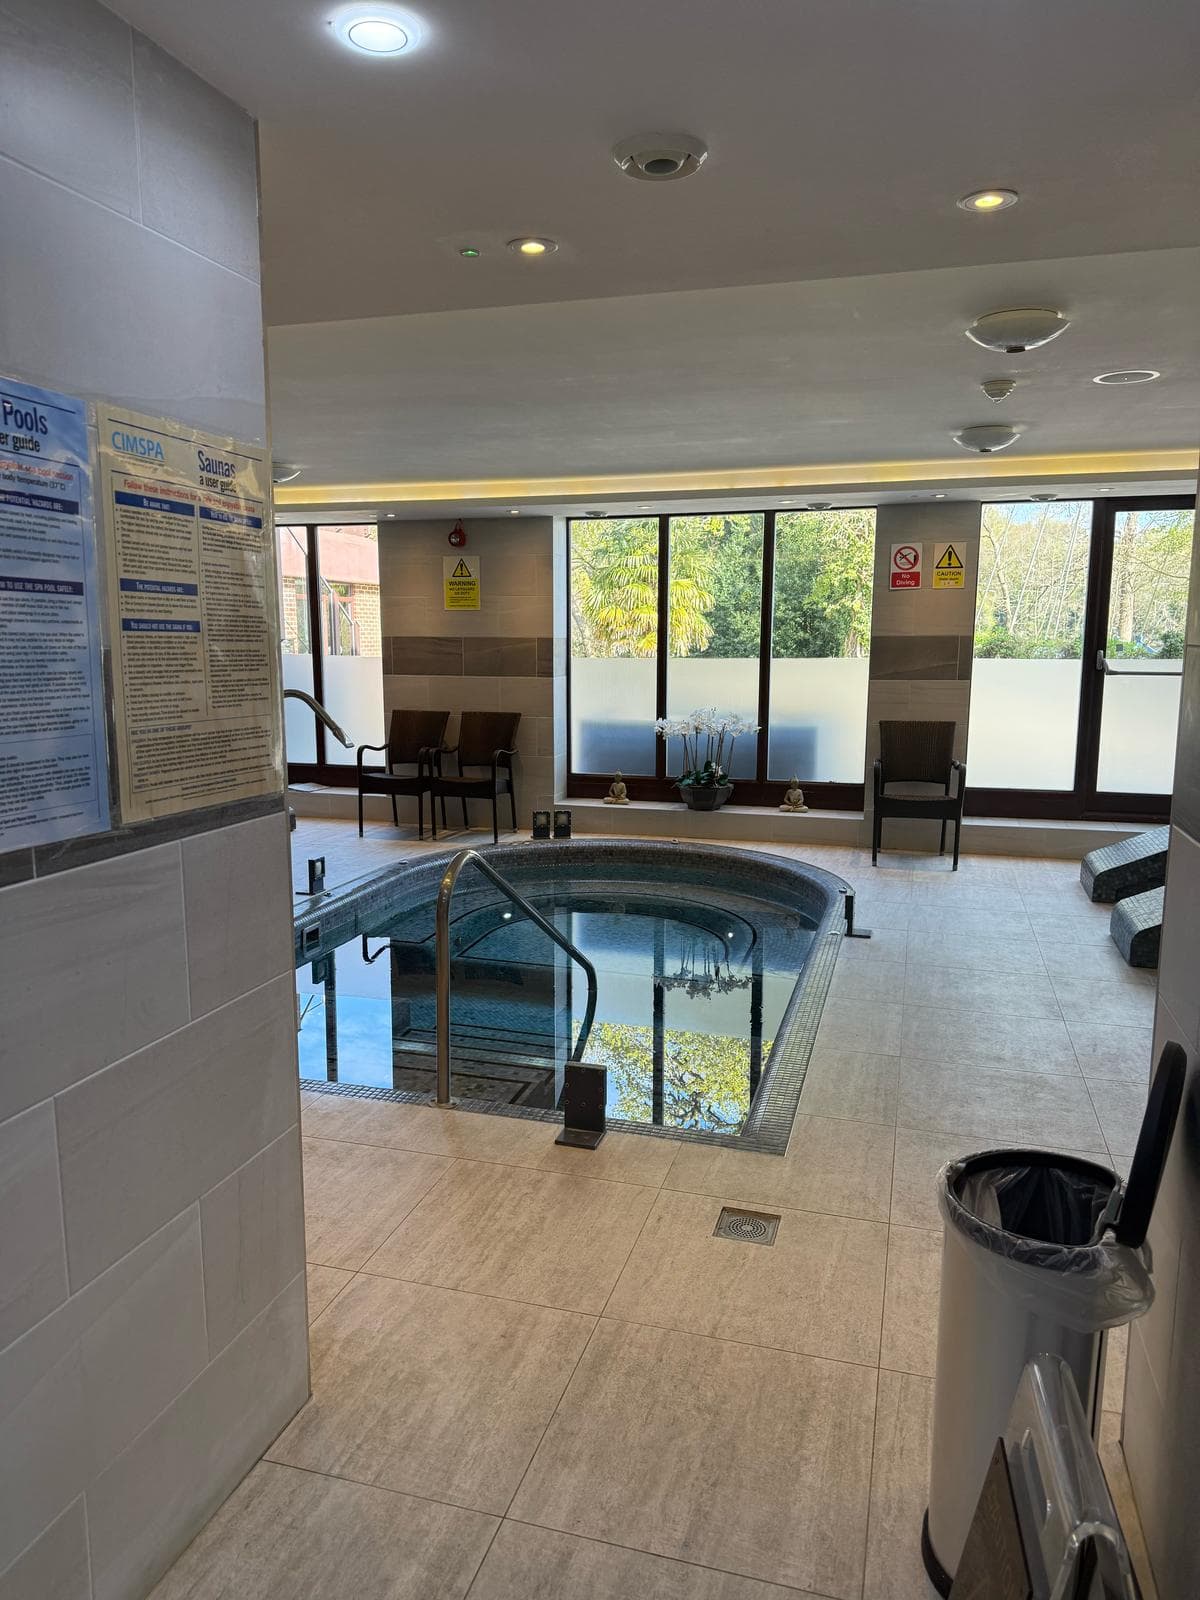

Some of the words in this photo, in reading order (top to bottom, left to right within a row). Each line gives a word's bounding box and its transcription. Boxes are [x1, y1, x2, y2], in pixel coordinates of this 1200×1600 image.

[2, 399, 49, 435] Pools
[12, 434, 41, 452] guide
[111, 431, 165, 460] CIMSPA
[197, 450, 236, 479] Saunas
[199, 475, 204, 485] a
[205, 476, 219, 488] user
